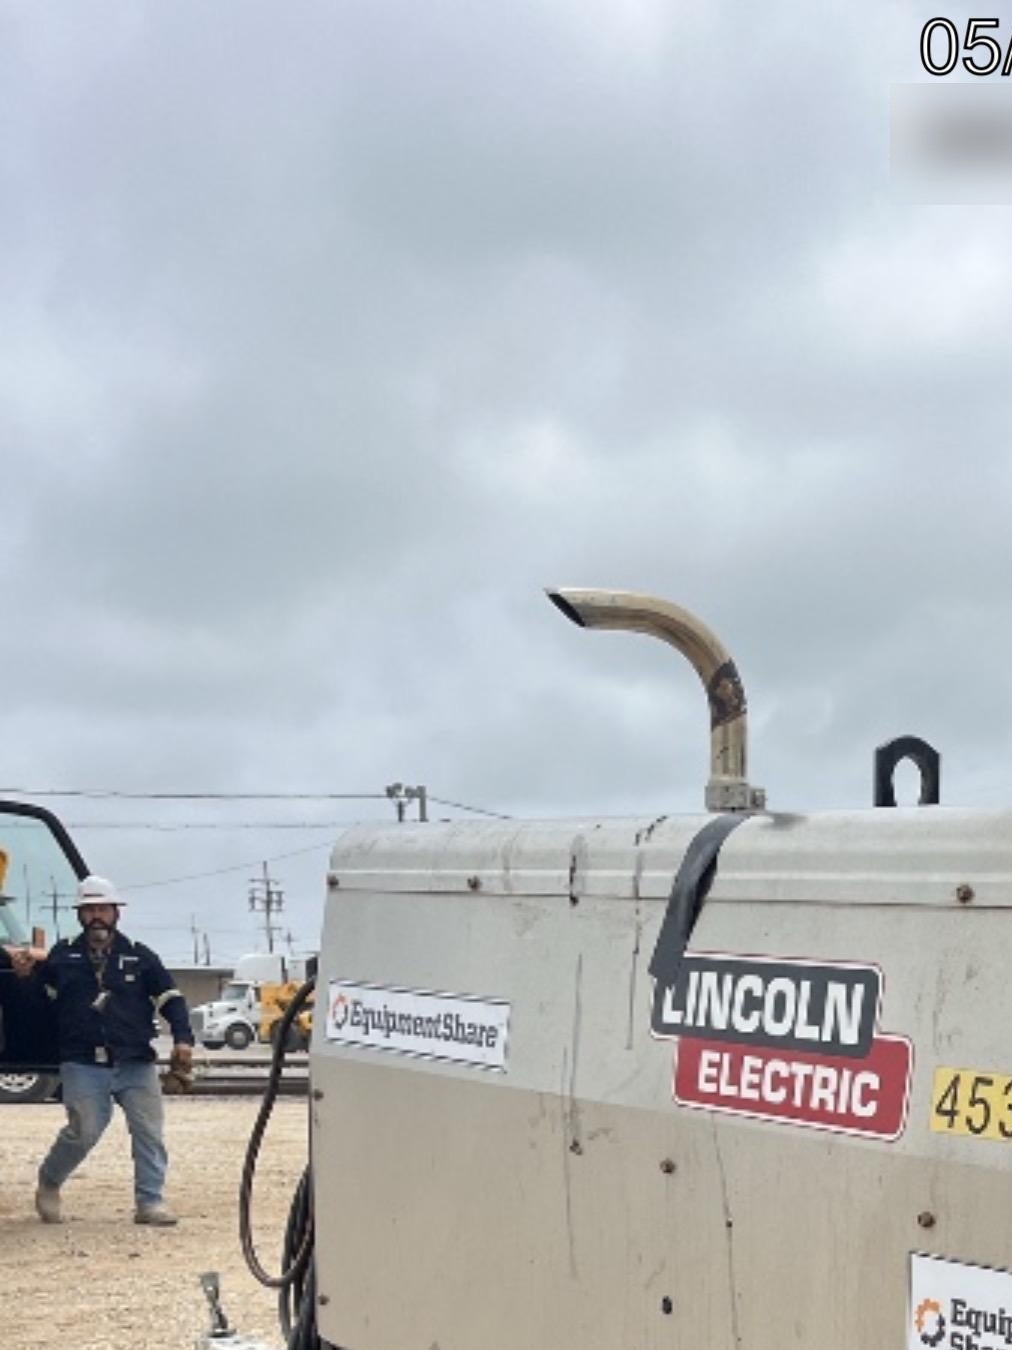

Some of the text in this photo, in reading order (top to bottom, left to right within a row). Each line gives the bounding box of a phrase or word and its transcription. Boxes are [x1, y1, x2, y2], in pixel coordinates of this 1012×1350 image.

[350, 1001, 499, 1048] EquipmentShare
[662, 971, 865, 1045] LINCOLN
[698, 1050, 880, 1117] ELECTRIC
